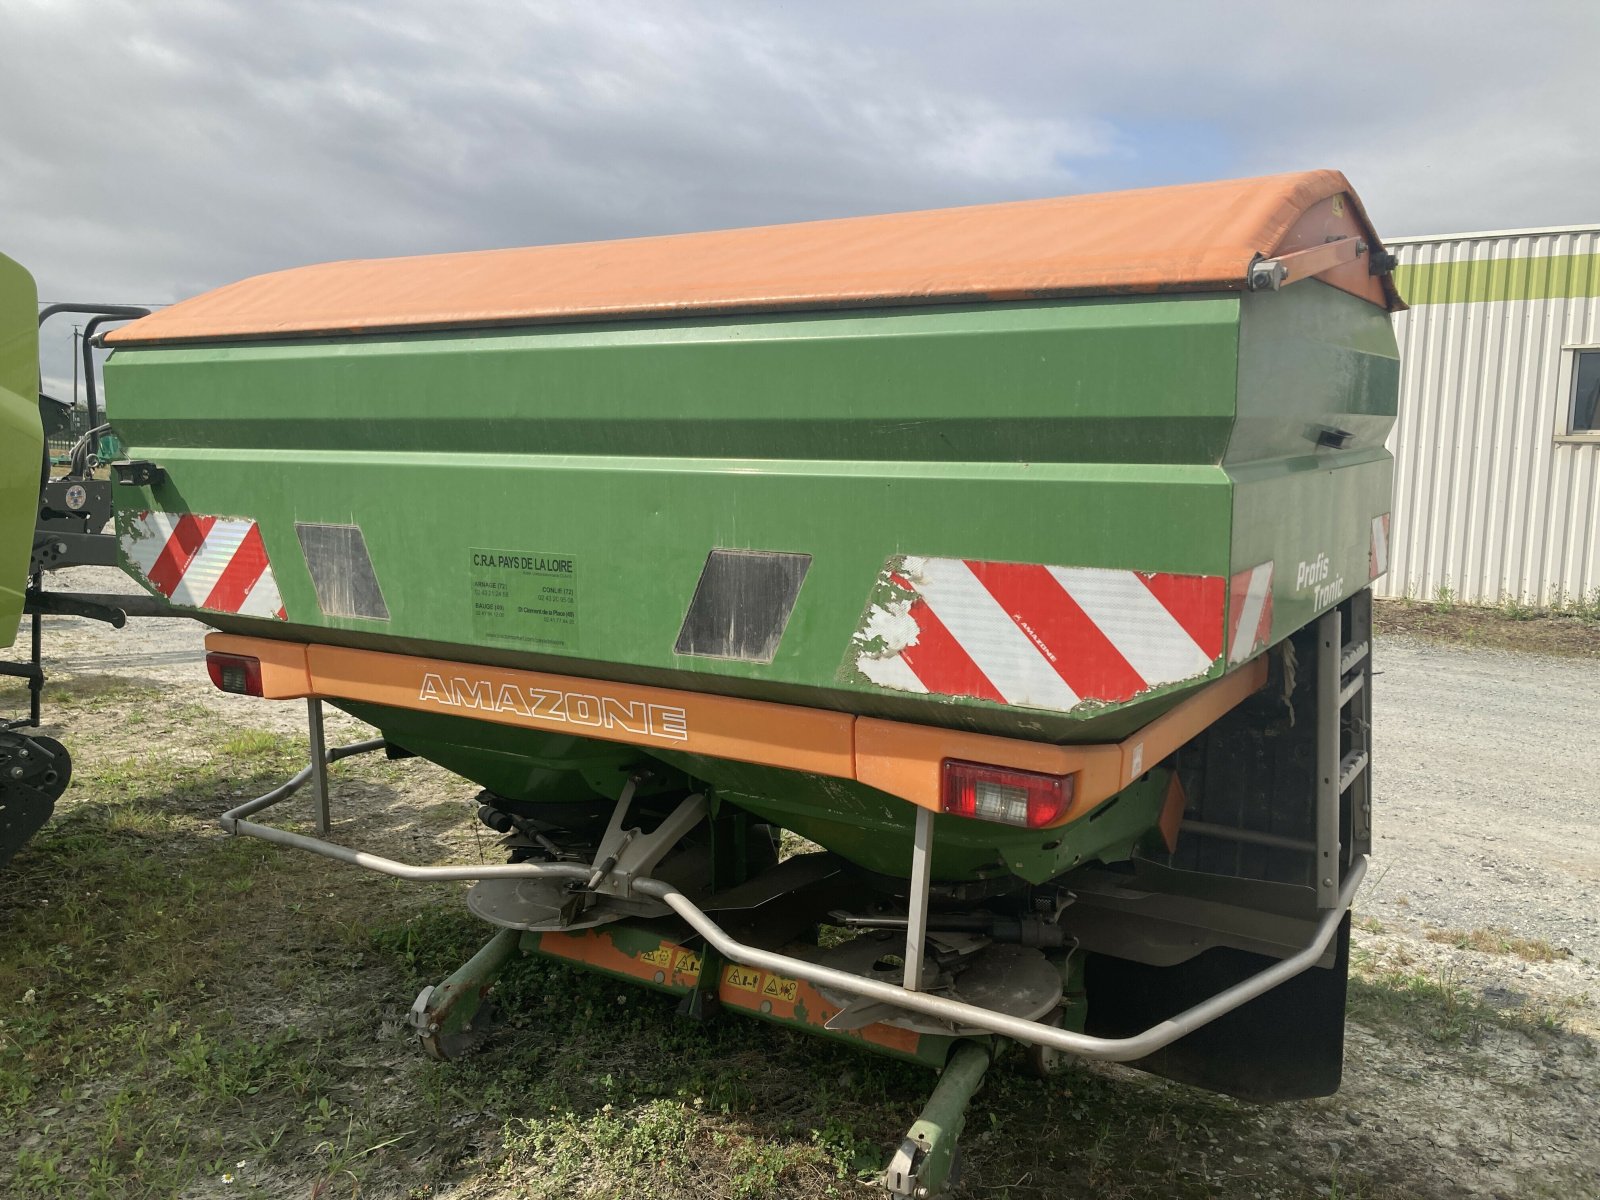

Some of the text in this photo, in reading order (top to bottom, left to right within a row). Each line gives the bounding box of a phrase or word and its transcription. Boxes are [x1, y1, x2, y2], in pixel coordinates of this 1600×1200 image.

[473, 554, 573, 573] C.R.A. PAYS DE LA LOIRE
[1296, 552, 1329, 591] Profis
[1313, 572, 1343, 613] Tronic
[1021, 622, 1057, 662] AMAZONE
[419, 673, 687, 740] AMAZONE
